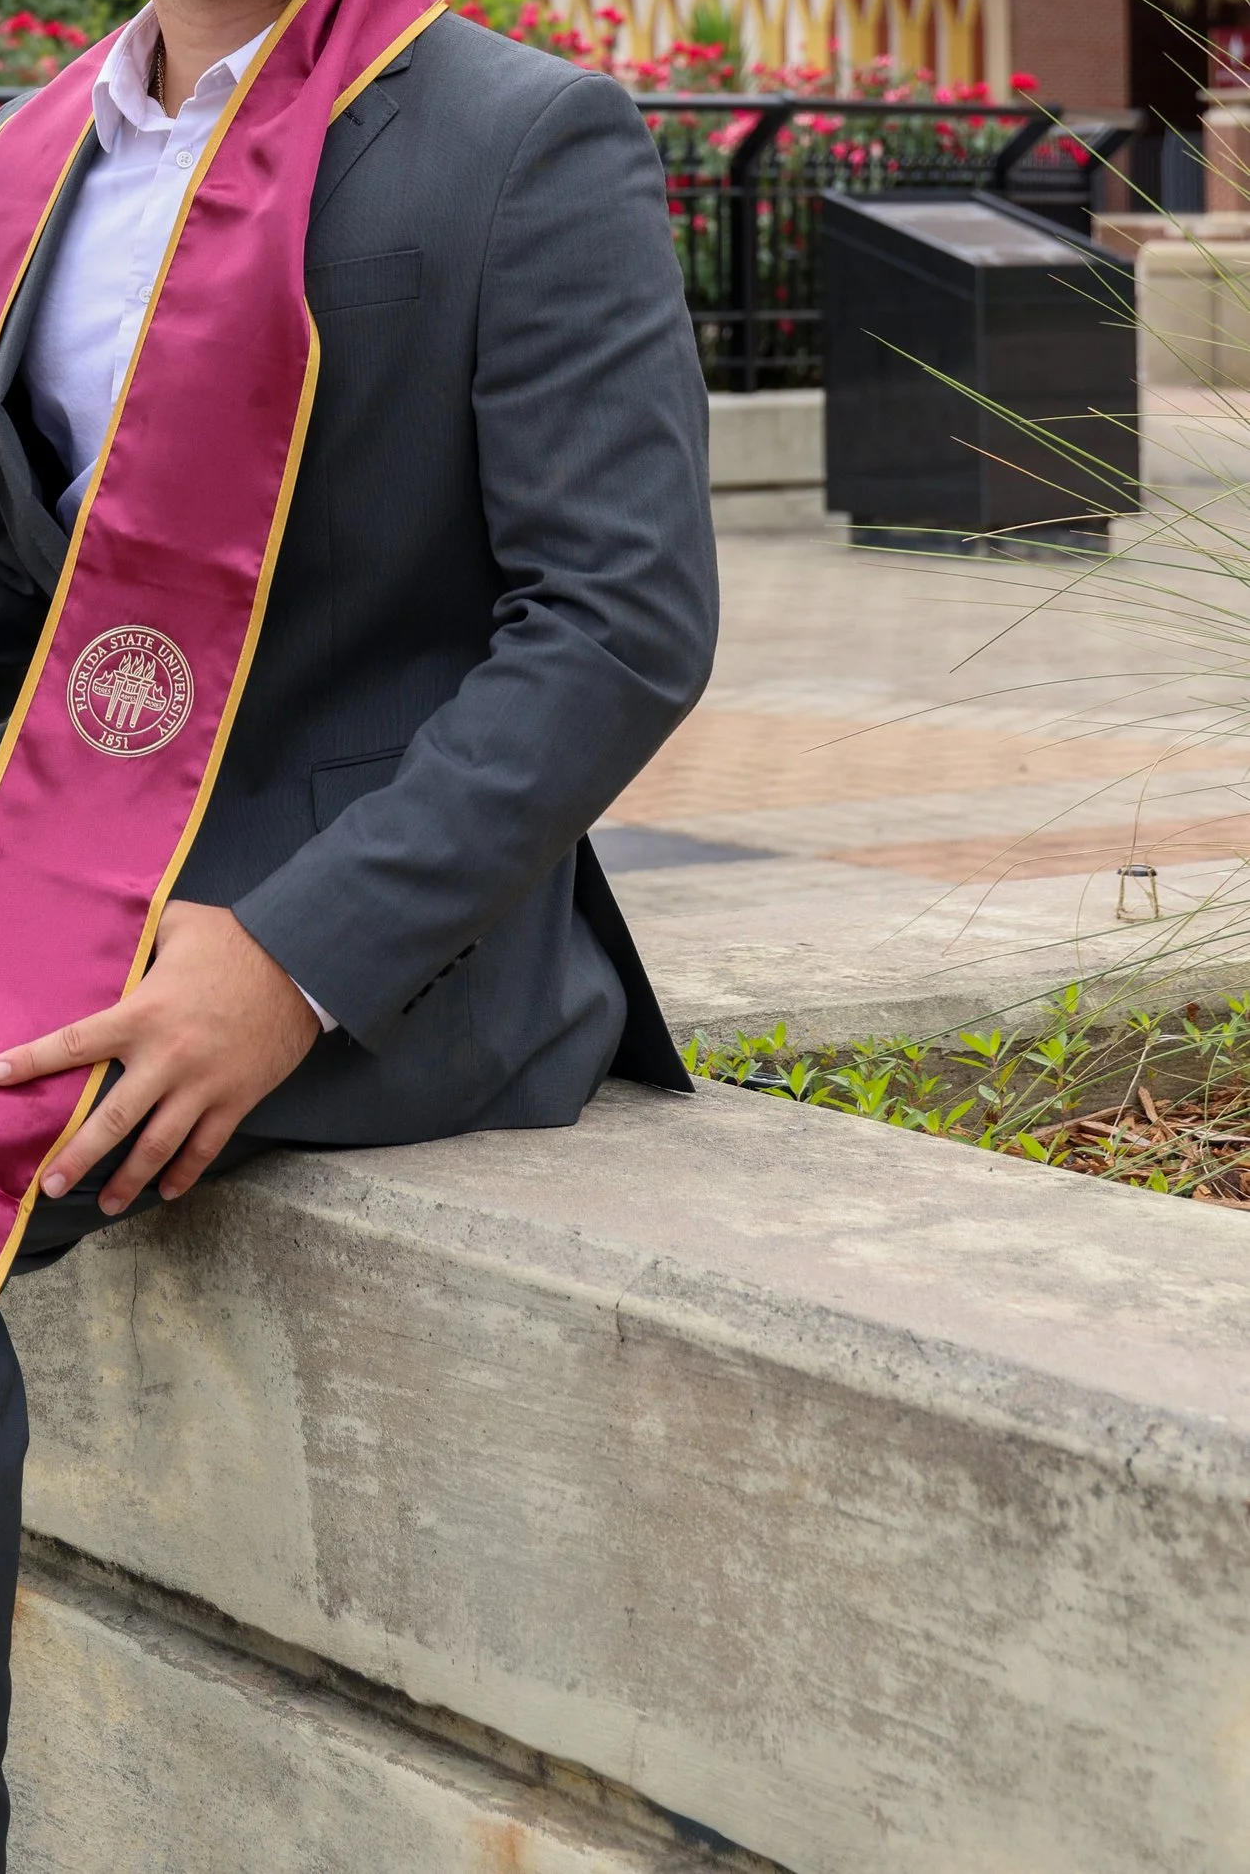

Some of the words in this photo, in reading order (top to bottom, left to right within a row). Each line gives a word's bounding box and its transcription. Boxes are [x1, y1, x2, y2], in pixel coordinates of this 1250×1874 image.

[75, 645, 107, 713] FLORIDA
[110, 633, 154, 649] STATE
[157, 644, 186, 737] UNIVERSITY
[99, 730, 129, 750] 1851
